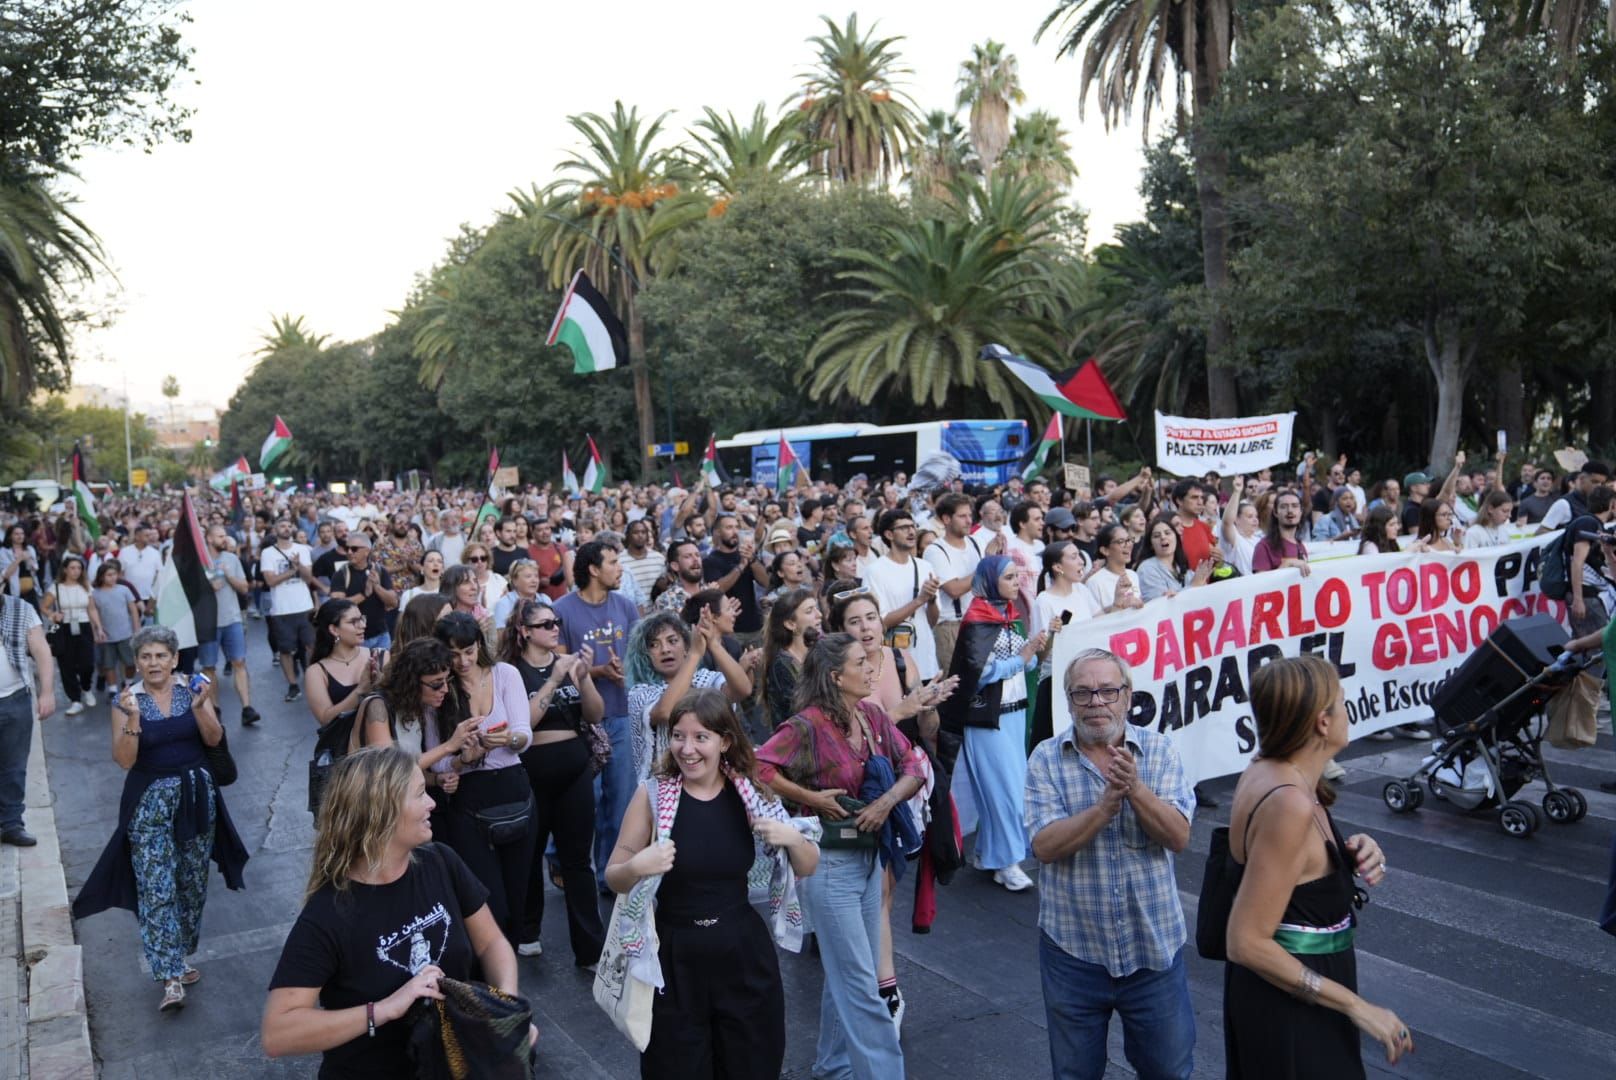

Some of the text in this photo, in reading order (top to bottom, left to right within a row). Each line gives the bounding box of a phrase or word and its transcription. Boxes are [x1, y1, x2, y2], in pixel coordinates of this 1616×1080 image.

[1166, 437, 1276, 456] PALESTINA LIBRE
[1109, 577, 1352, 681] PARARLO
[1361, 560, 1482, 620] TODO
[378, 902, 445, 947] فلسطين حرة
